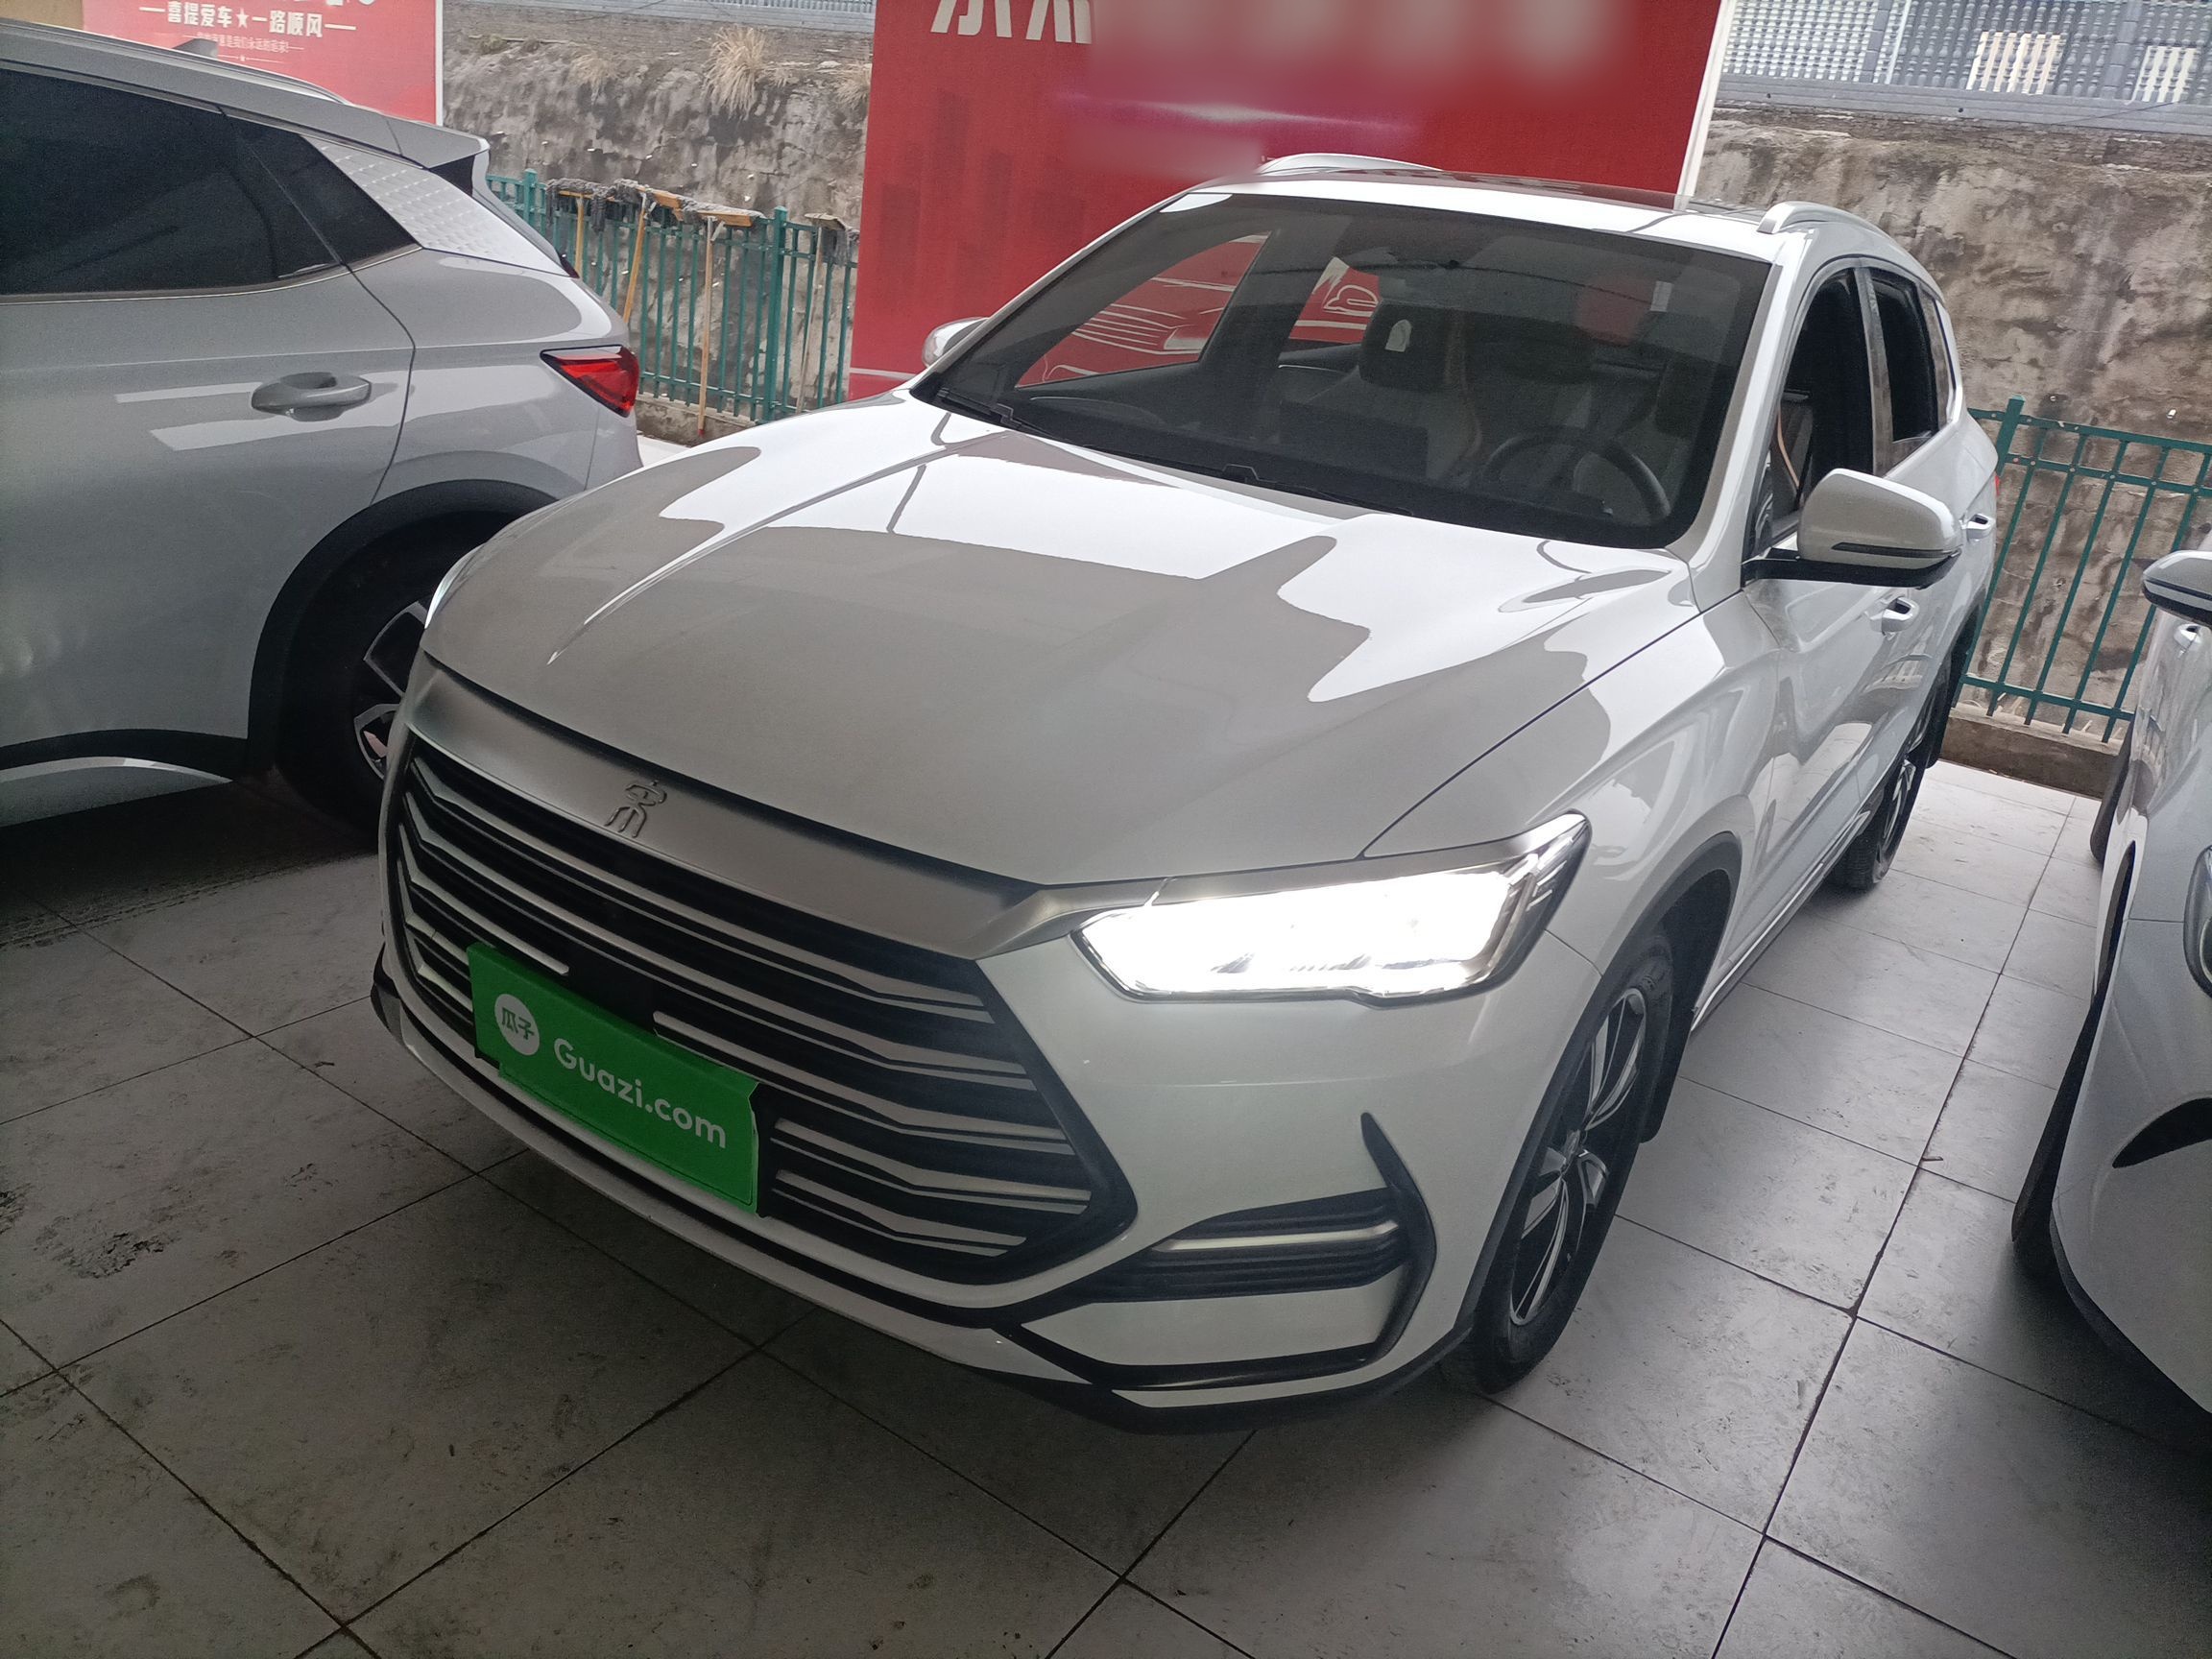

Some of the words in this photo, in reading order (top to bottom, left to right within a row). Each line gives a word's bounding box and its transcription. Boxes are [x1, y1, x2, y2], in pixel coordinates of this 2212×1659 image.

[167, 1, 233, 28] 喜提爱车
[252, 10, 324, 38] 一路顺风
[501, 1006, 535, 1041] 瓜子
[553, 1038, 727, 1149] Guazi.com
